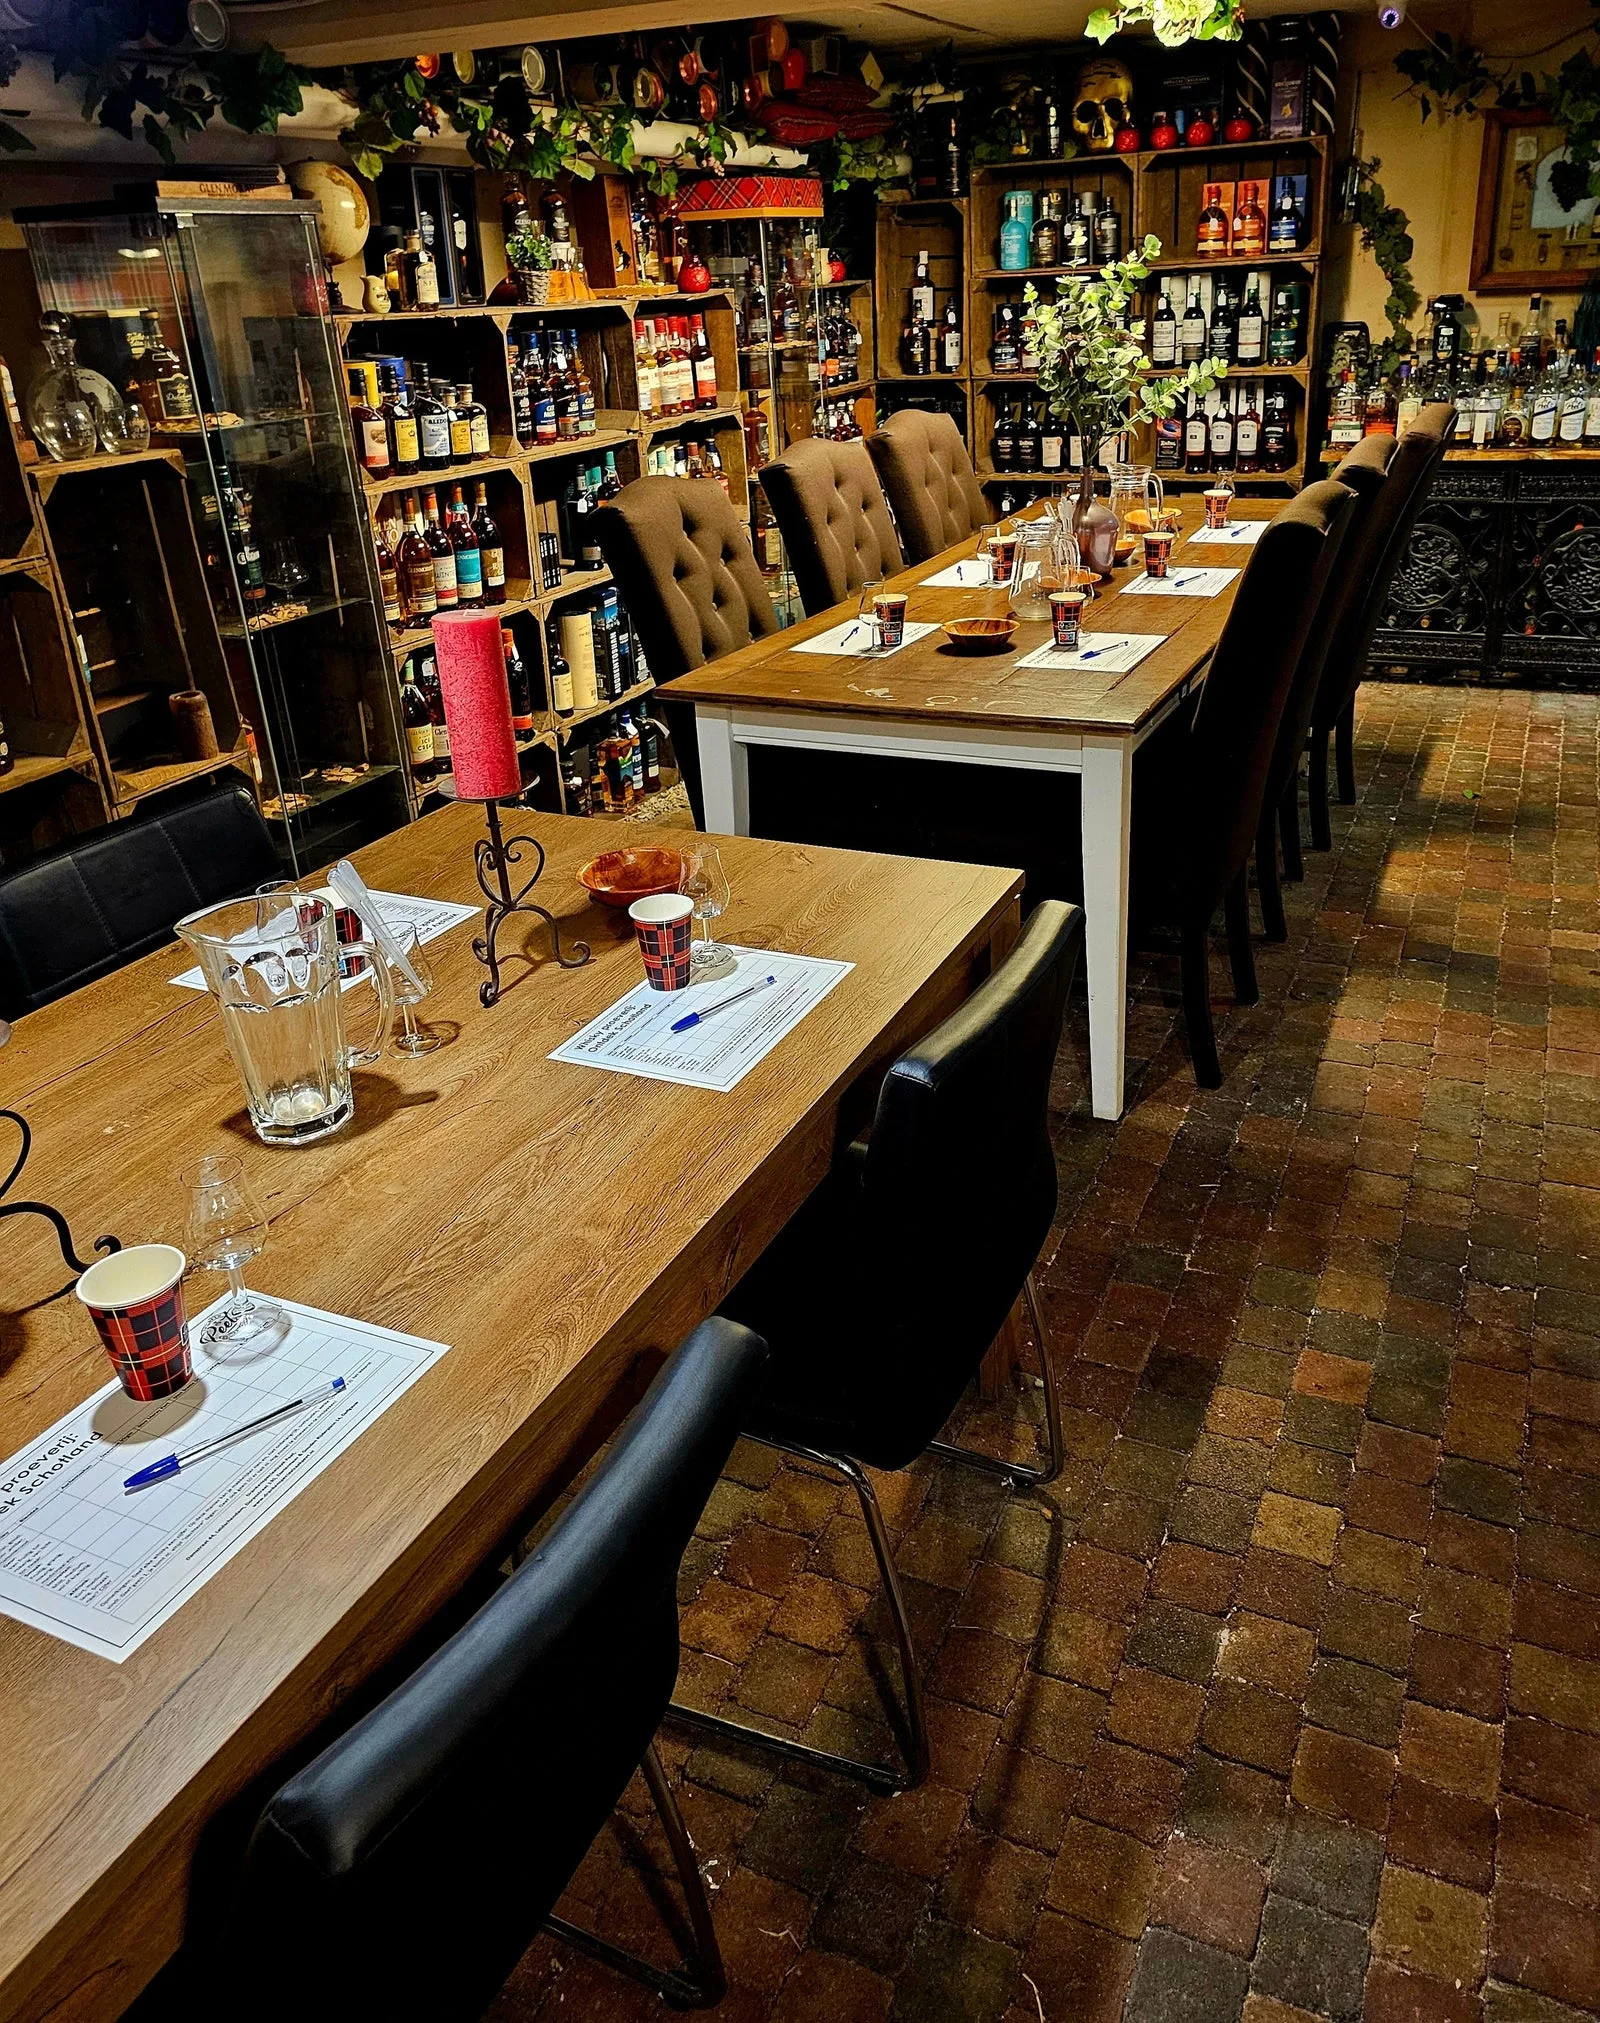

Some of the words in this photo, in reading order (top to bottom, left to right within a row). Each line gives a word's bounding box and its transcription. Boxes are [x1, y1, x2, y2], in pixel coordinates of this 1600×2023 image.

[200, 183, 221, 193] GLEN
[574, 1030, 604, 1050] Whisky
[601, 1004, 637, 1031] proeverij:
[587, 1030, 619, 1053] Ontdek
[614, 1003, 652, 1032] Schotland
[1, 1432, 79, 1493] proeverij:
[19, 1431, 104, 1495] Schotland
